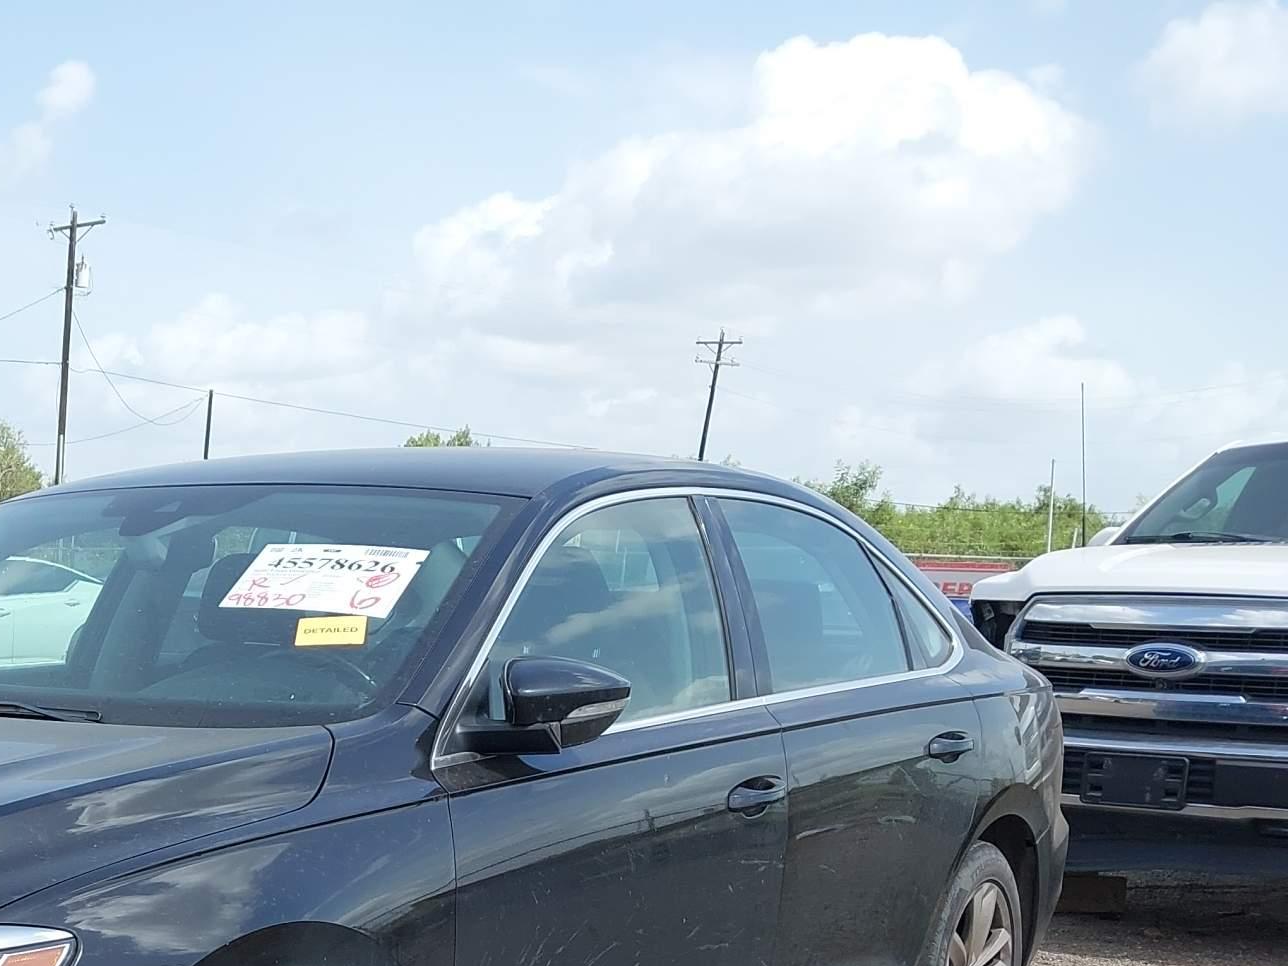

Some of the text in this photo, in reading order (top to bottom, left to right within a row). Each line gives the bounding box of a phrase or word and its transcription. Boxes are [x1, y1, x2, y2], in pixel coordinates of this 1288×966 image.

[268, 556, 399, 573] 45578626
[303, 626, 359, 635] DETAILED
[1138, 650, 1182, 668] Ford
